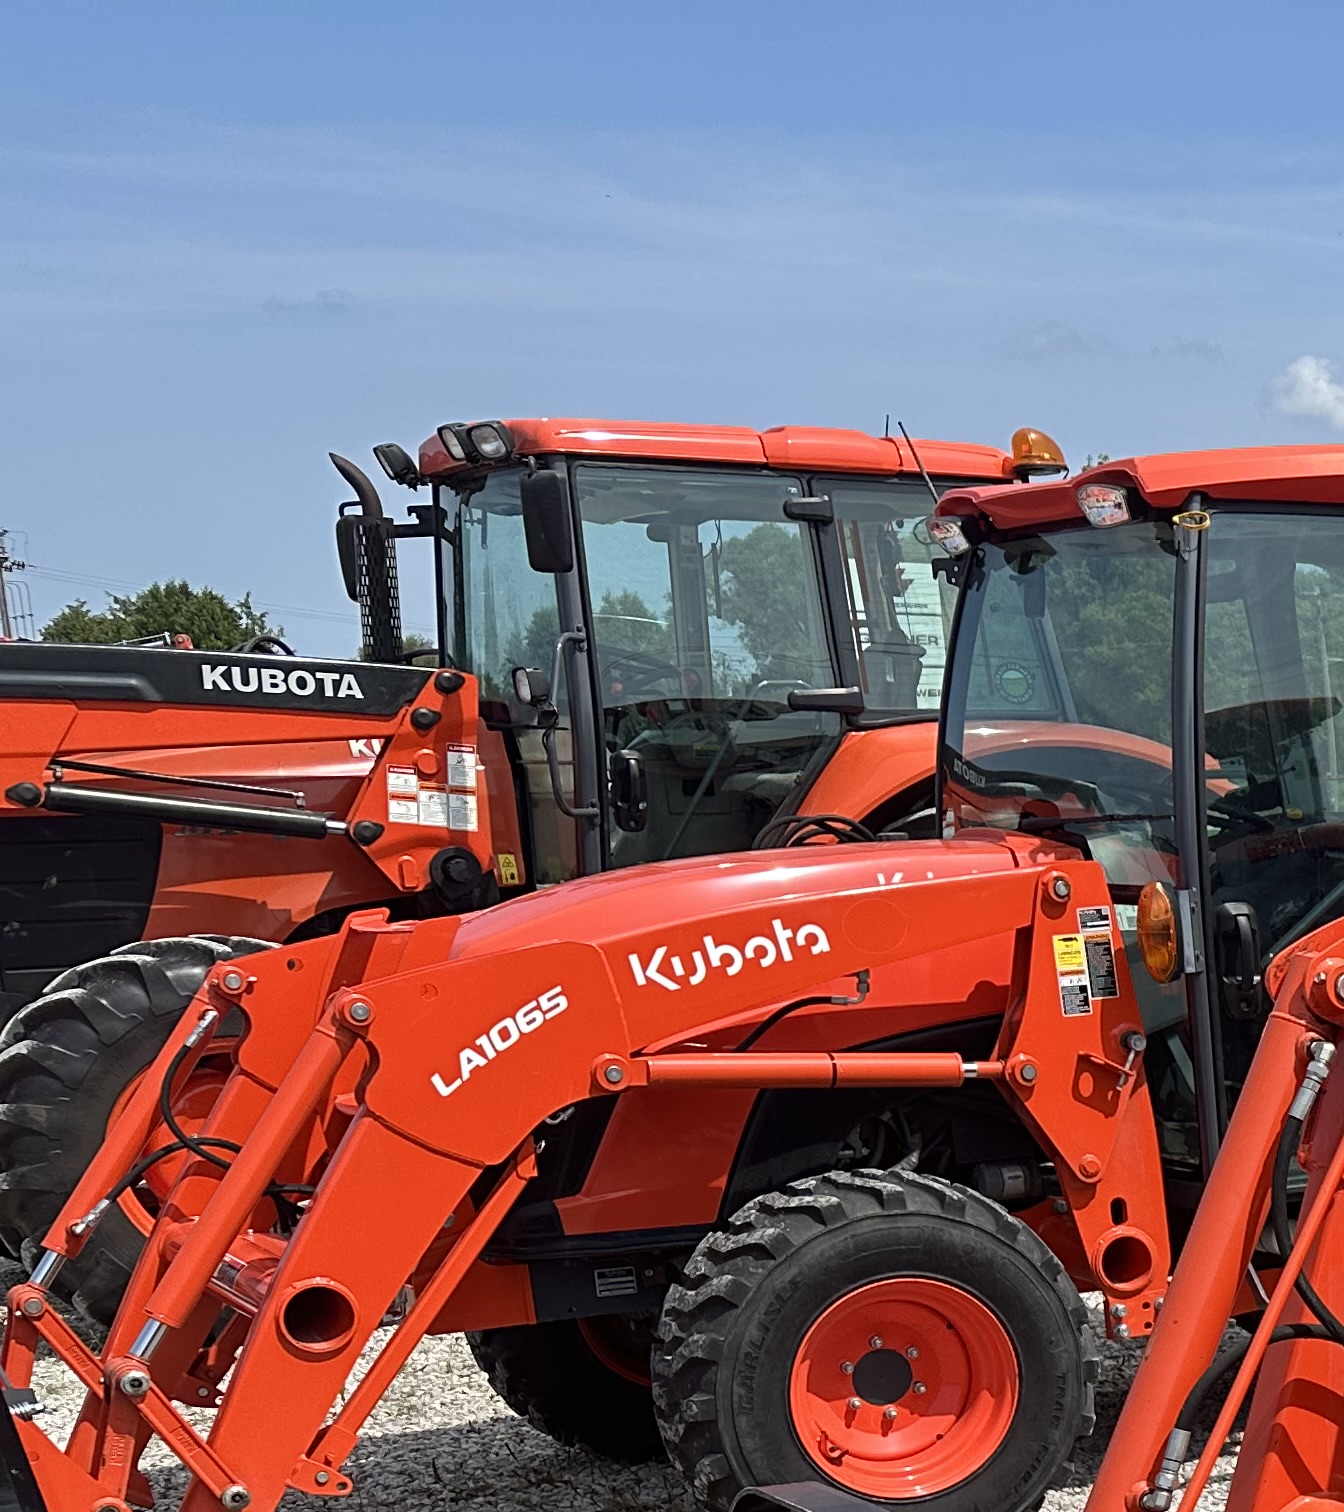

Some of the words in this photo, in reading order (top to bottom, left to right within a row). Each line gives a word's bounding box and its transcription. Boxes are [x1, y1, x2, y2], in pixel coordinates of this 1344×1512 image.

[201, 664, 364, 699] KUBOTA
[628, 918, 831, 991] Kubota
[430, 985, 568, 1098] LA1065
[737, 1275, 808, 1416] CARLISLE
